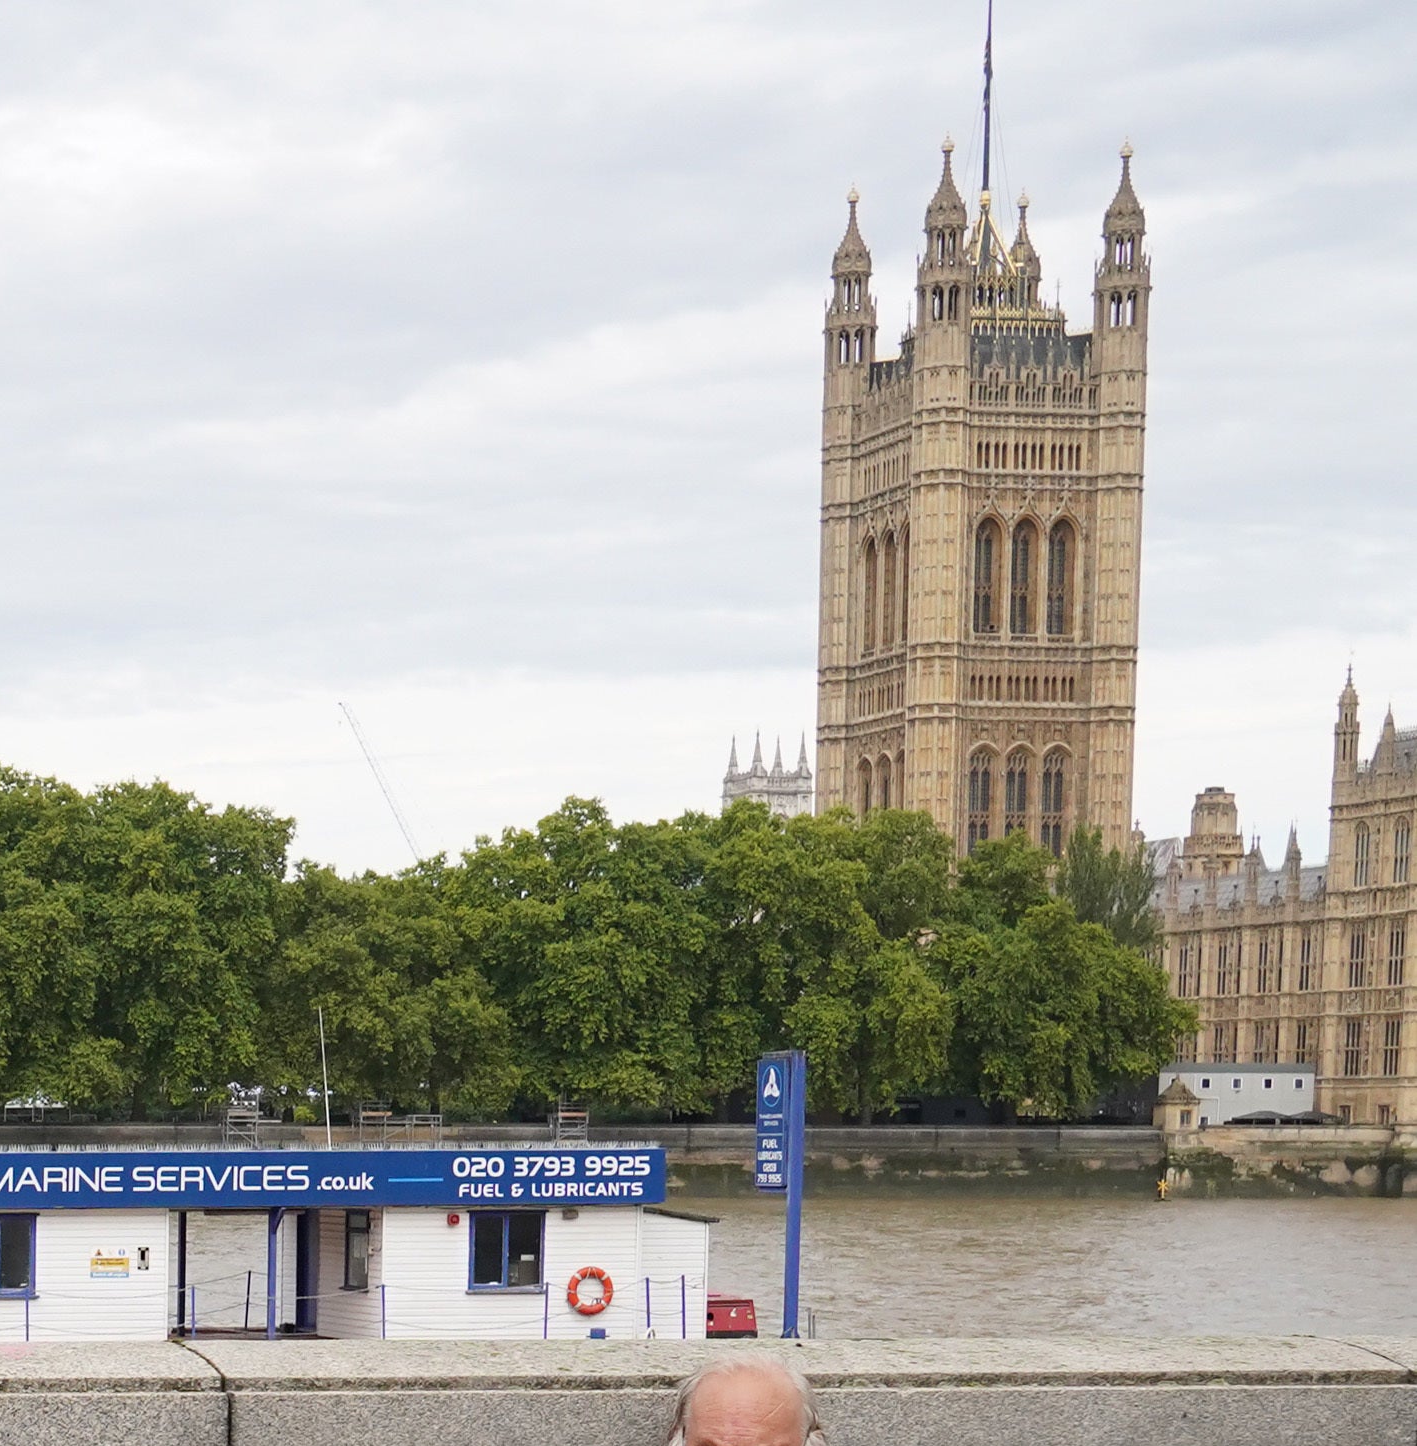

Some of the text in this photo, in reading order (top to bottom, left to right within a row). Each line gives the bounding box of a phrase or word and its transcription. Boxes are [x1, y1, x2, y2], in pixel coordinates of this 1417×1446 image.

[452, 1155, 651, 1178] 020 3793 9925
[131, 1165, 310, 1192] SERVICES
[458, 1182, 644, 1198] FUEL & LUBRICANTS
